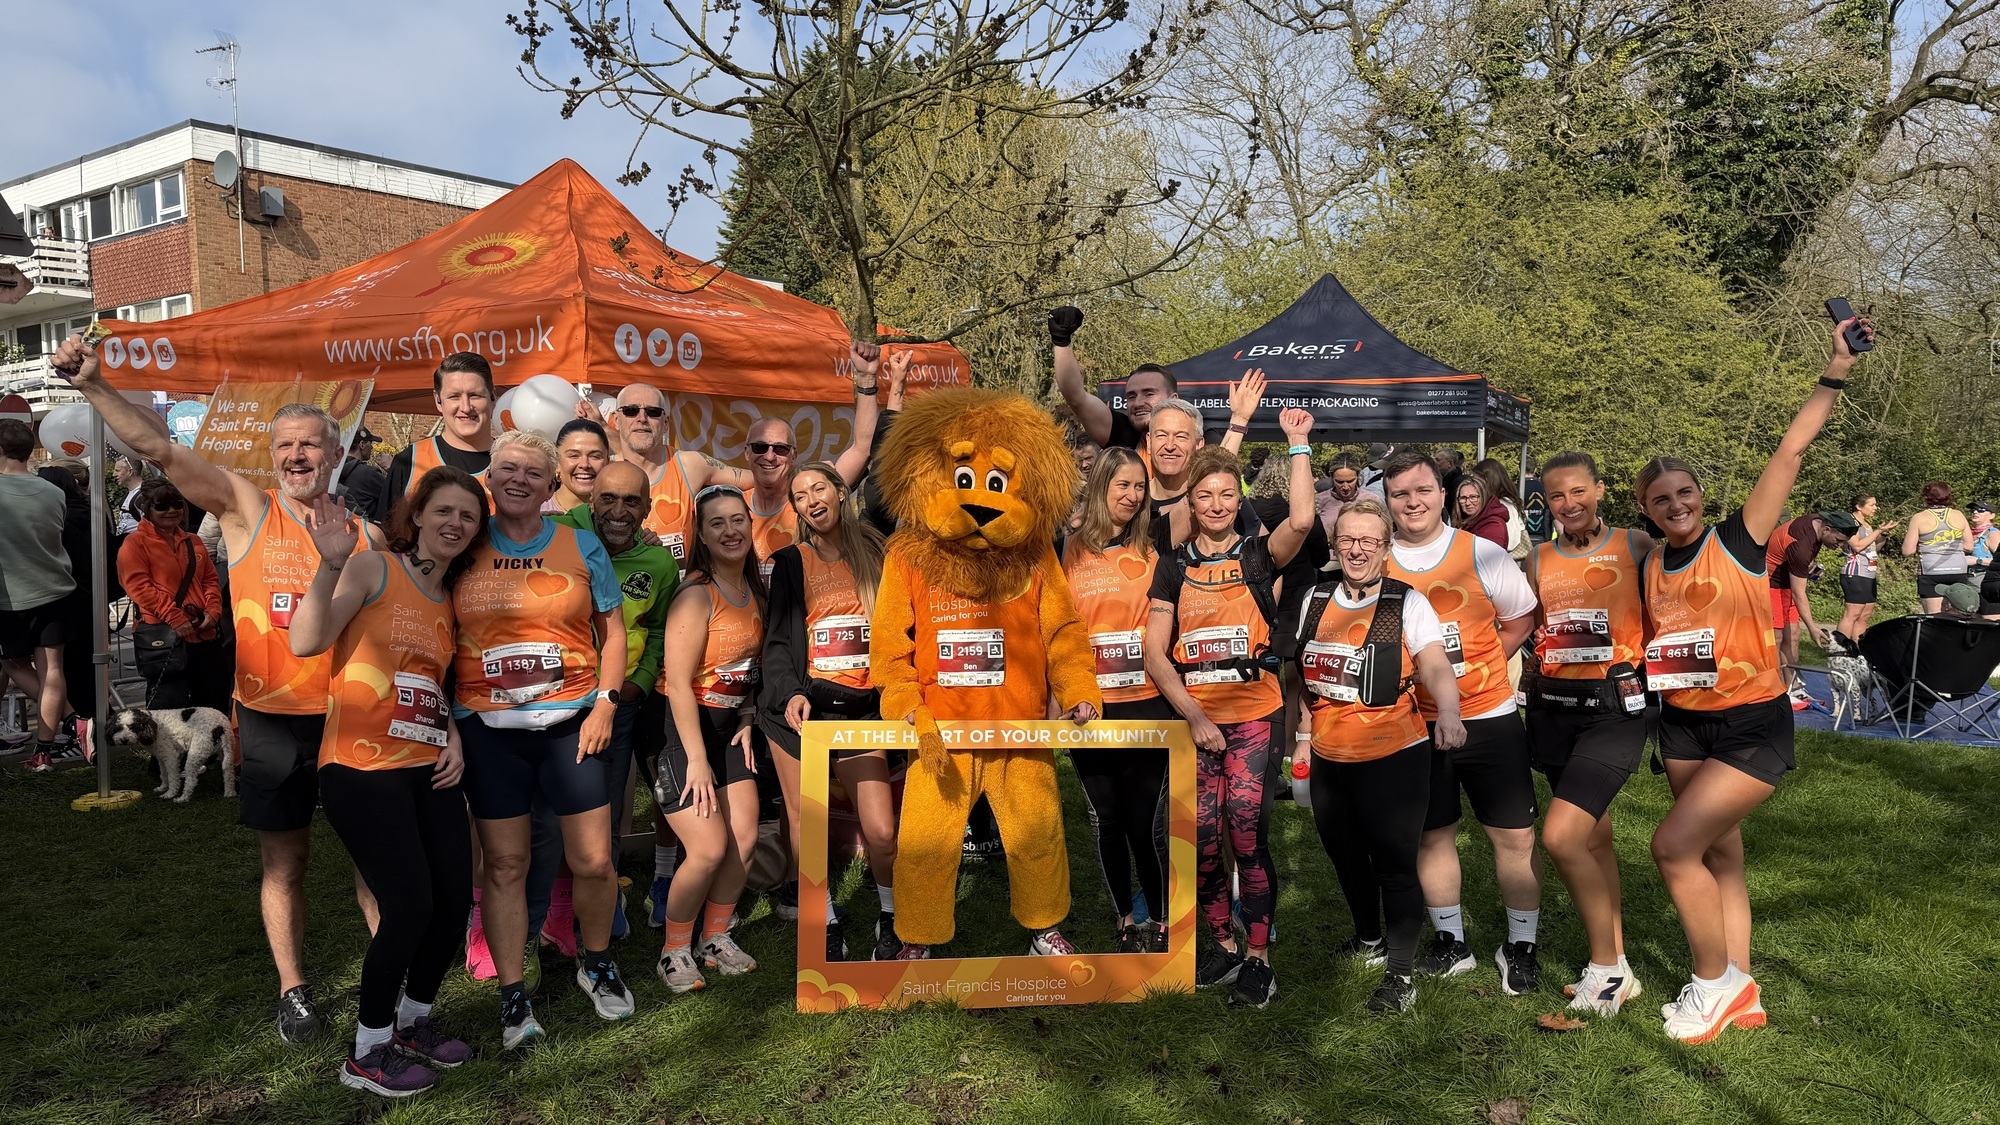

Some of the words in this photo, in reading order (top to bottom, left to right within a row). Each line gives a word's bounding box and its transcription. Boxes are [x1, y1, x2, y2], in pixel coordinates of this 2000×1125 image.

[324, 315, 555, 367] www.sfh.org.uk
[1247, 342, 1347, 357] Bakers
[216, 399, 235, 414] We
[237, 401, 259, 413] are
[1194, 401, 1231, 409] LABELS
[1260, 398, 1309, 408] FLEXIBLE
[1311, 398, 1379, 408] PACKAGING
[208, 417, 240, 432] Saint
[200, 434, 253, 454] Hospice
[264, 535, 300, 549] Saint
[263, 548, 313, 565] Francis
[1588, 555, 1619, 563] ROSIE
[262, 562, 317, 578] Hospice
[493, 558, 544, 570] VICKY
[262, 576, 288, 585] Caring
[289, 577, 301, 585] for
[464, 569, 501, 580] Saint
[808, 571, 836, 586] Saint
[1073, 566, 1114, 582] Francis
[461, 579, 517, 591] Francis
[812, 579, 851, 596] Francis
[1075, 575, 1120, 592] Hospice
[460, 591, 524, 604] Hospice
[815, 588, 857, 607] Hospice
[1078, 589, 1097, 599] Caring
[1571, 598, 1585, 606] you
[393, 603, 423, 620] Saint
[462, 605, 486, 613] Caring
[931, 614, 957, 623] Caring
[959, 611, 971, 619] for
[973, 610, 988, 619] you
[392, 617, 433, 636] Francis
[718, 621, 744, 632] Saint
[1563, 624, 1583, 633] 796
[1679, 621, 1692, 629] you
[390, 630, 437, 651] Hospice
[835, 630, 855, 641] 725
[389, 643, 413, 653] Caring
[414, 647, 424, 655] for
[424, 651, 436, 659] you
[957, 646, 983, 657] 2159
[1098, 647, 1123, 659] 1699
[1201, 642, 1227, 654] 1065
[1666, 647, 1689, 658] 863
[506, 658, 536, 671] 1387
[1319, 657, 1341, 668] 1142
[419, 694, 437, 708] 360
[414, 713, 436, 725] Sharon
[832, 730, 856, 744] AT
[861, 730, 897, 744] THE
[903, 729, 964, 744] HRT
[969, 729, 995, 743] OF
[1000, 729, 1051, 743] YOUR
[1057, 729, 1168, 743] COMMUNITY
[962, 838, 999, 852] sbury's
[902, 980, 942, 995] Saint
[946, 978, 1001, 993] Francis
[1006, 976, 1067, 992] Hospice
[1006, 993, 1034, 1003] Caring
[1036, 993, 1048, 1002] for
[1049, 993, 1066, 1003] you
